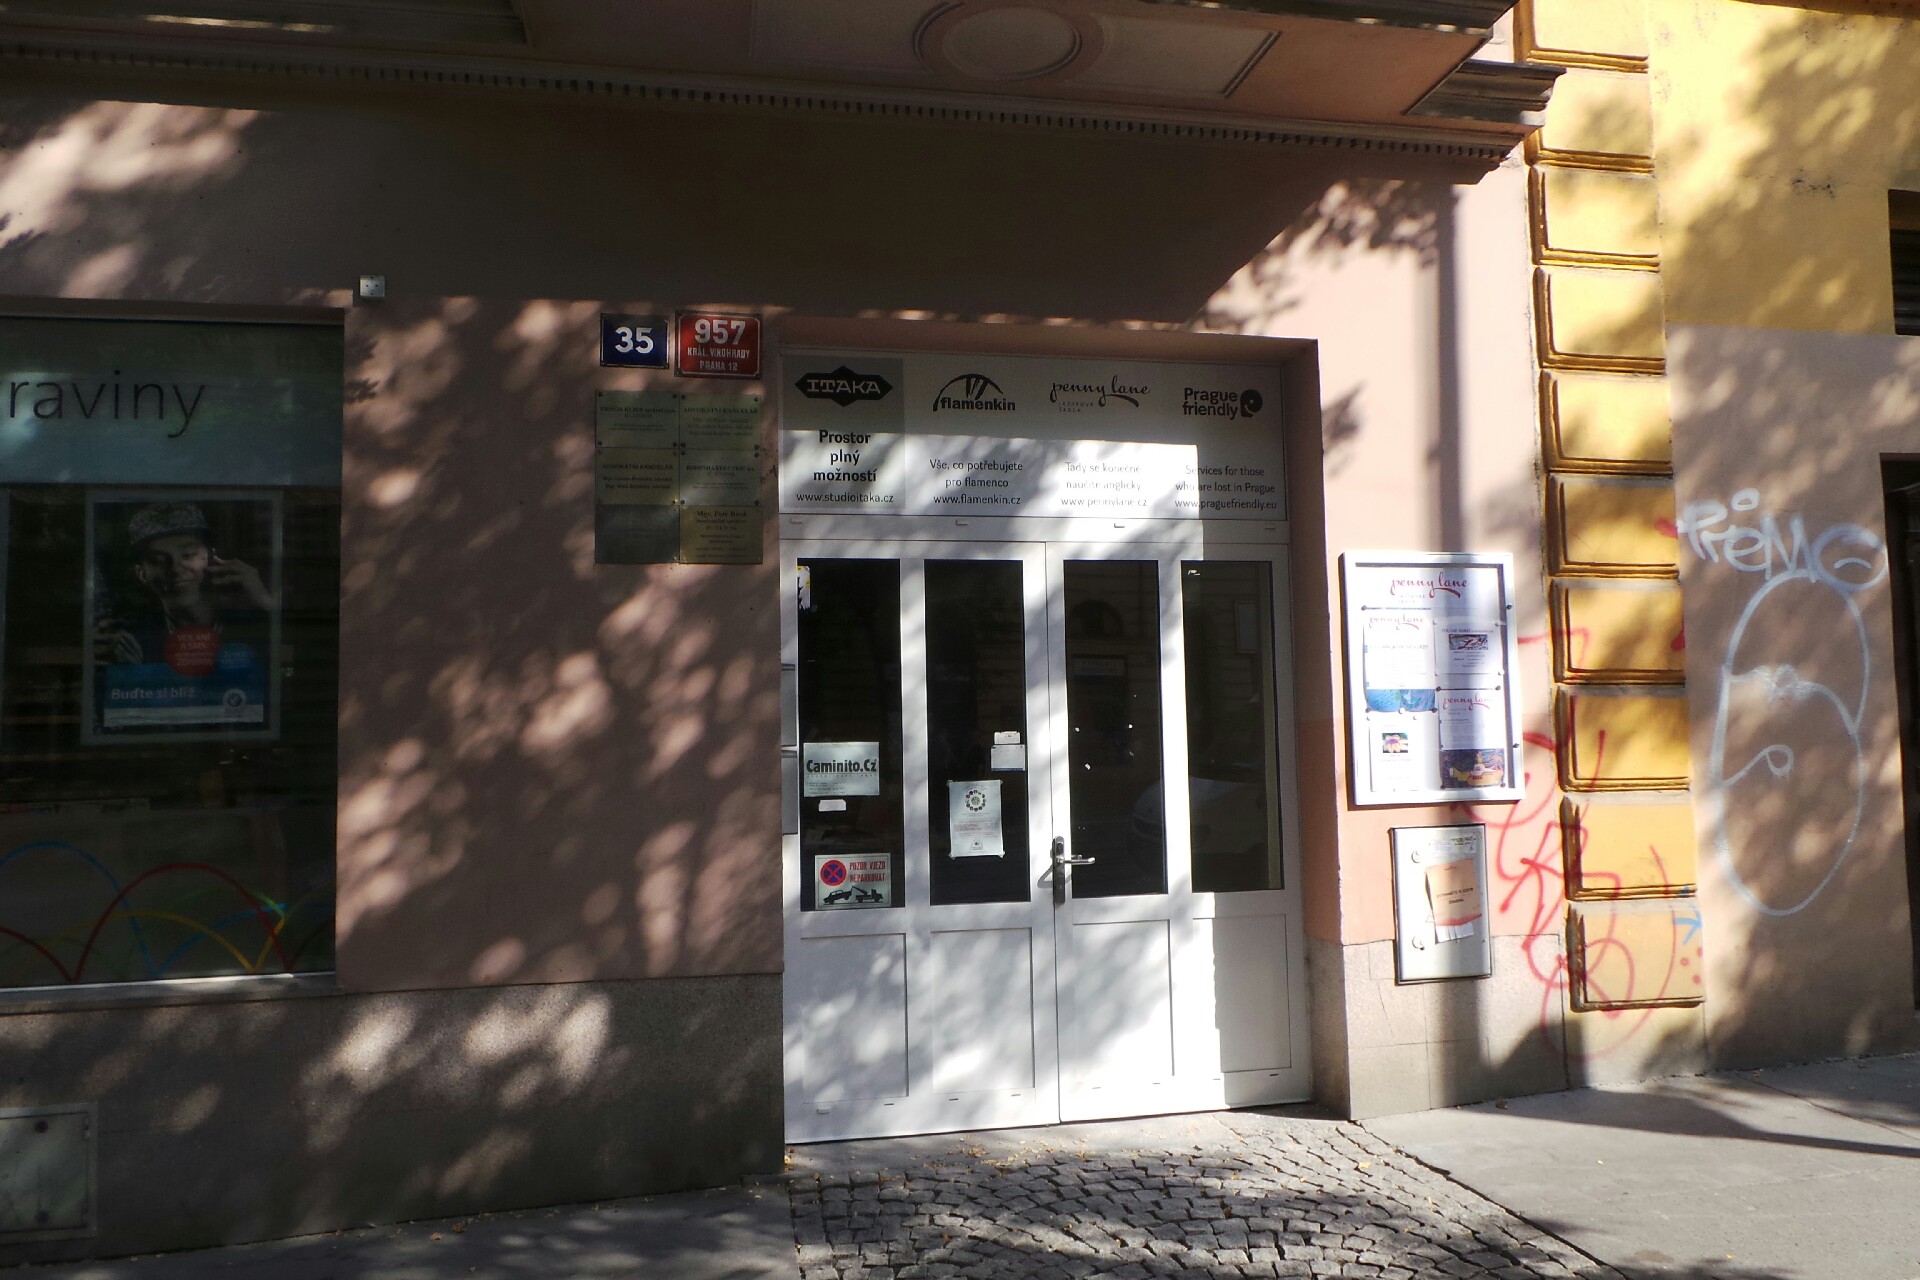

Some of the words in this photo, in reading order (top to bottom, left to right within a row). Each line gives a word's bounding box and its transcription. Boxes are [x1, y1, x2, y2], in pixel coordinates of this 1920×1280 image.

[694, 319, 746, 345] 957
[614, 326, 654, 354] 35
[710, 349, 750, 359] VINOHRADY
[699, 361, 726, 371] PRAHA
[728, 361, 738, 371] 12
[806, 379, 881, 394] ITAKA
[1050, 381, 1107, 408] penny
[1111, 374, 1150, 396] lane
[1183, 387, 1238, 404] Prague
[9, 369, 205, 439] raviny
[940, 396, 1016, 411] flamenkin
[1182, 400, 1238, 420] friendly
[818, 429, 871, 444] Prostor
[830, 450, 860, 466] plný
[929, 458, 950, 471] Vše,
[952, 461, 964, 470] co
[967, 459, 1023, 473] potřebujete
[813, 467, 877, 483] možností
[1064, 461, 1087, 474] Tady
[1089, 464, 1100, 473] se
[1185, 464, 1223, 476] Services
[1225, 465, 1238, 476] for
[1239, 466, 1265, 477] those
[945, 479, 962, 489] pro
[964, 477, 1009, 488] flamenco
[1102, 480, 1142, 492] anglicky
[1175, 481, 1195, 491] who
[1198, 483, 1212, 492] are
[1214, 481, 1231, 492] lost
[1233, 482, 1243, 492] in
[1244, 482, 1276, 495] Prague
[796, 491, 894, 503] www.studioitaka.cz
[933, 493, 1021, 505] www.flamenkin.cz
[1060, 496, 1148, 508] www.pennylane.cz
[1174, 498, 1278, 511] www.praguefriendly.eu
[1389, 577, 1436, 599] penny
[1438, 571, 1470, 590] lane
[111, 687, 153, 700] Buďte
[156, 688, 167, 699] si
[171, 686, 196, 698] blíž
[1442, 695, 1476, 711] penny
[806, 758, 877, 773] Caminito.Cz
[849, 861, 868, 871] POZOR
[869, 860, 887, 870] VJEZD
[849, 872, 886, 883] NEPARKOVAT
